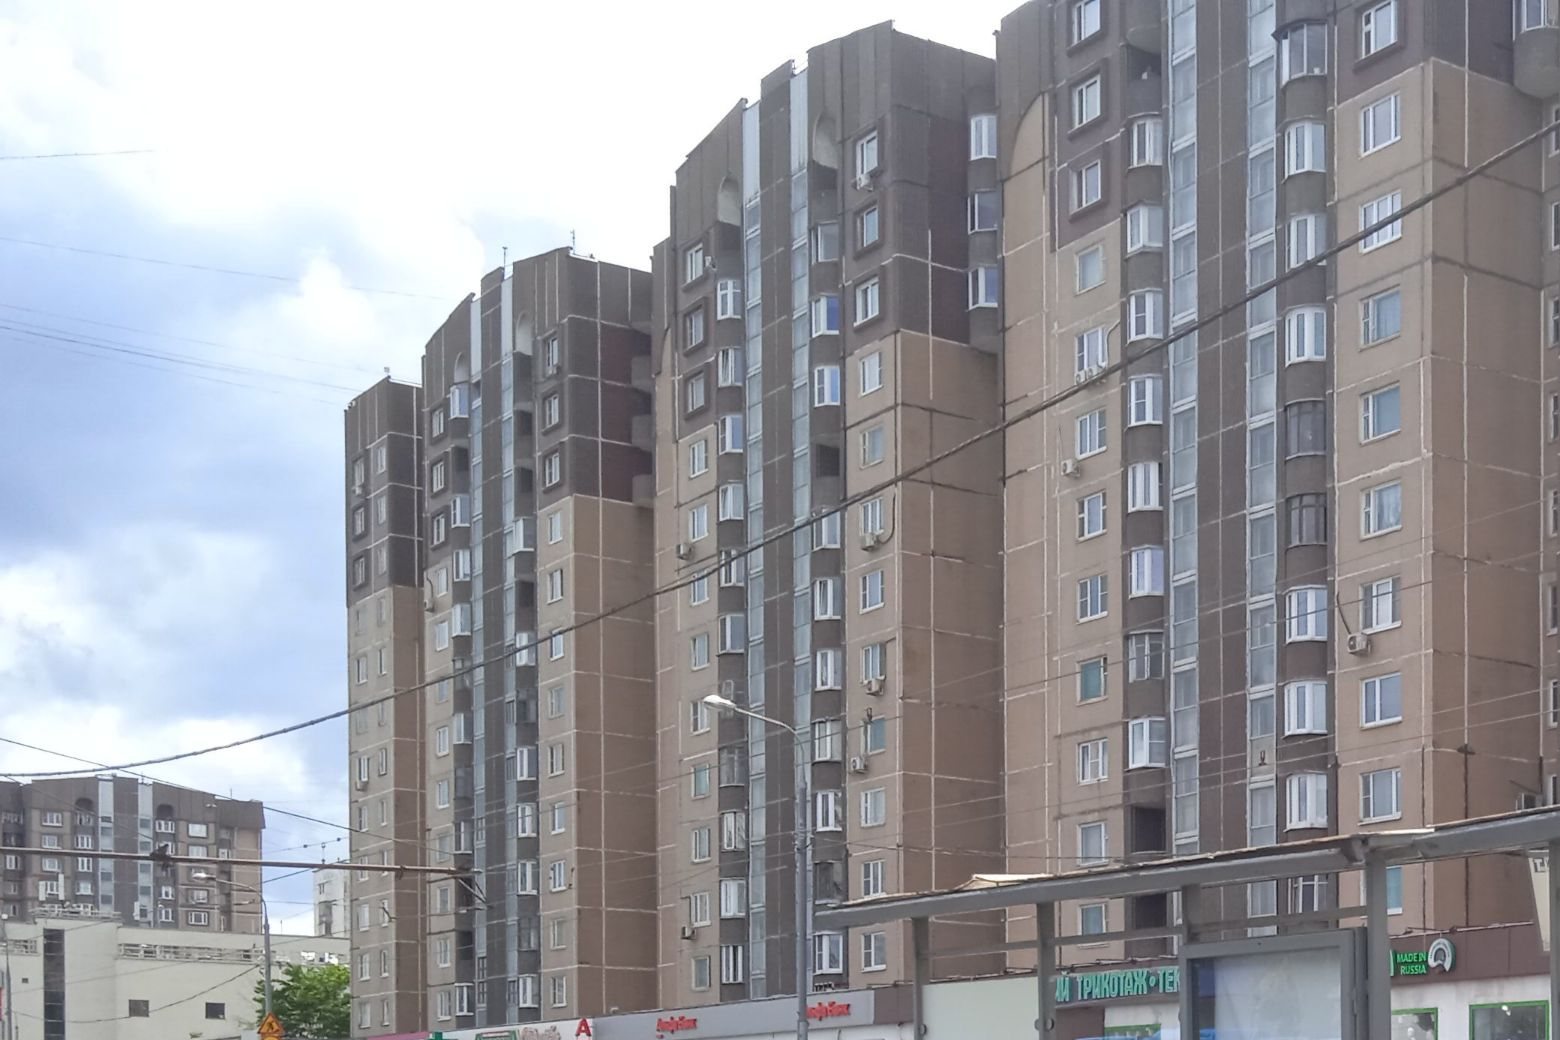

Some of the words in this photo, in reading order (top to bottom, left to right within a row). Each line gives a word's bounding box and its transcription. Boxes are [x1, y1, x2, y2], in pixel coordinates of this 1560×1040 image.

[1397, 953, 1418, 963] MADE
[1419, 952, 1427, 962] IN
[1400, 964, 1427, 975] RUSSIA
[1076, 970, 1148, 1000] ТРИКОТАЖ
